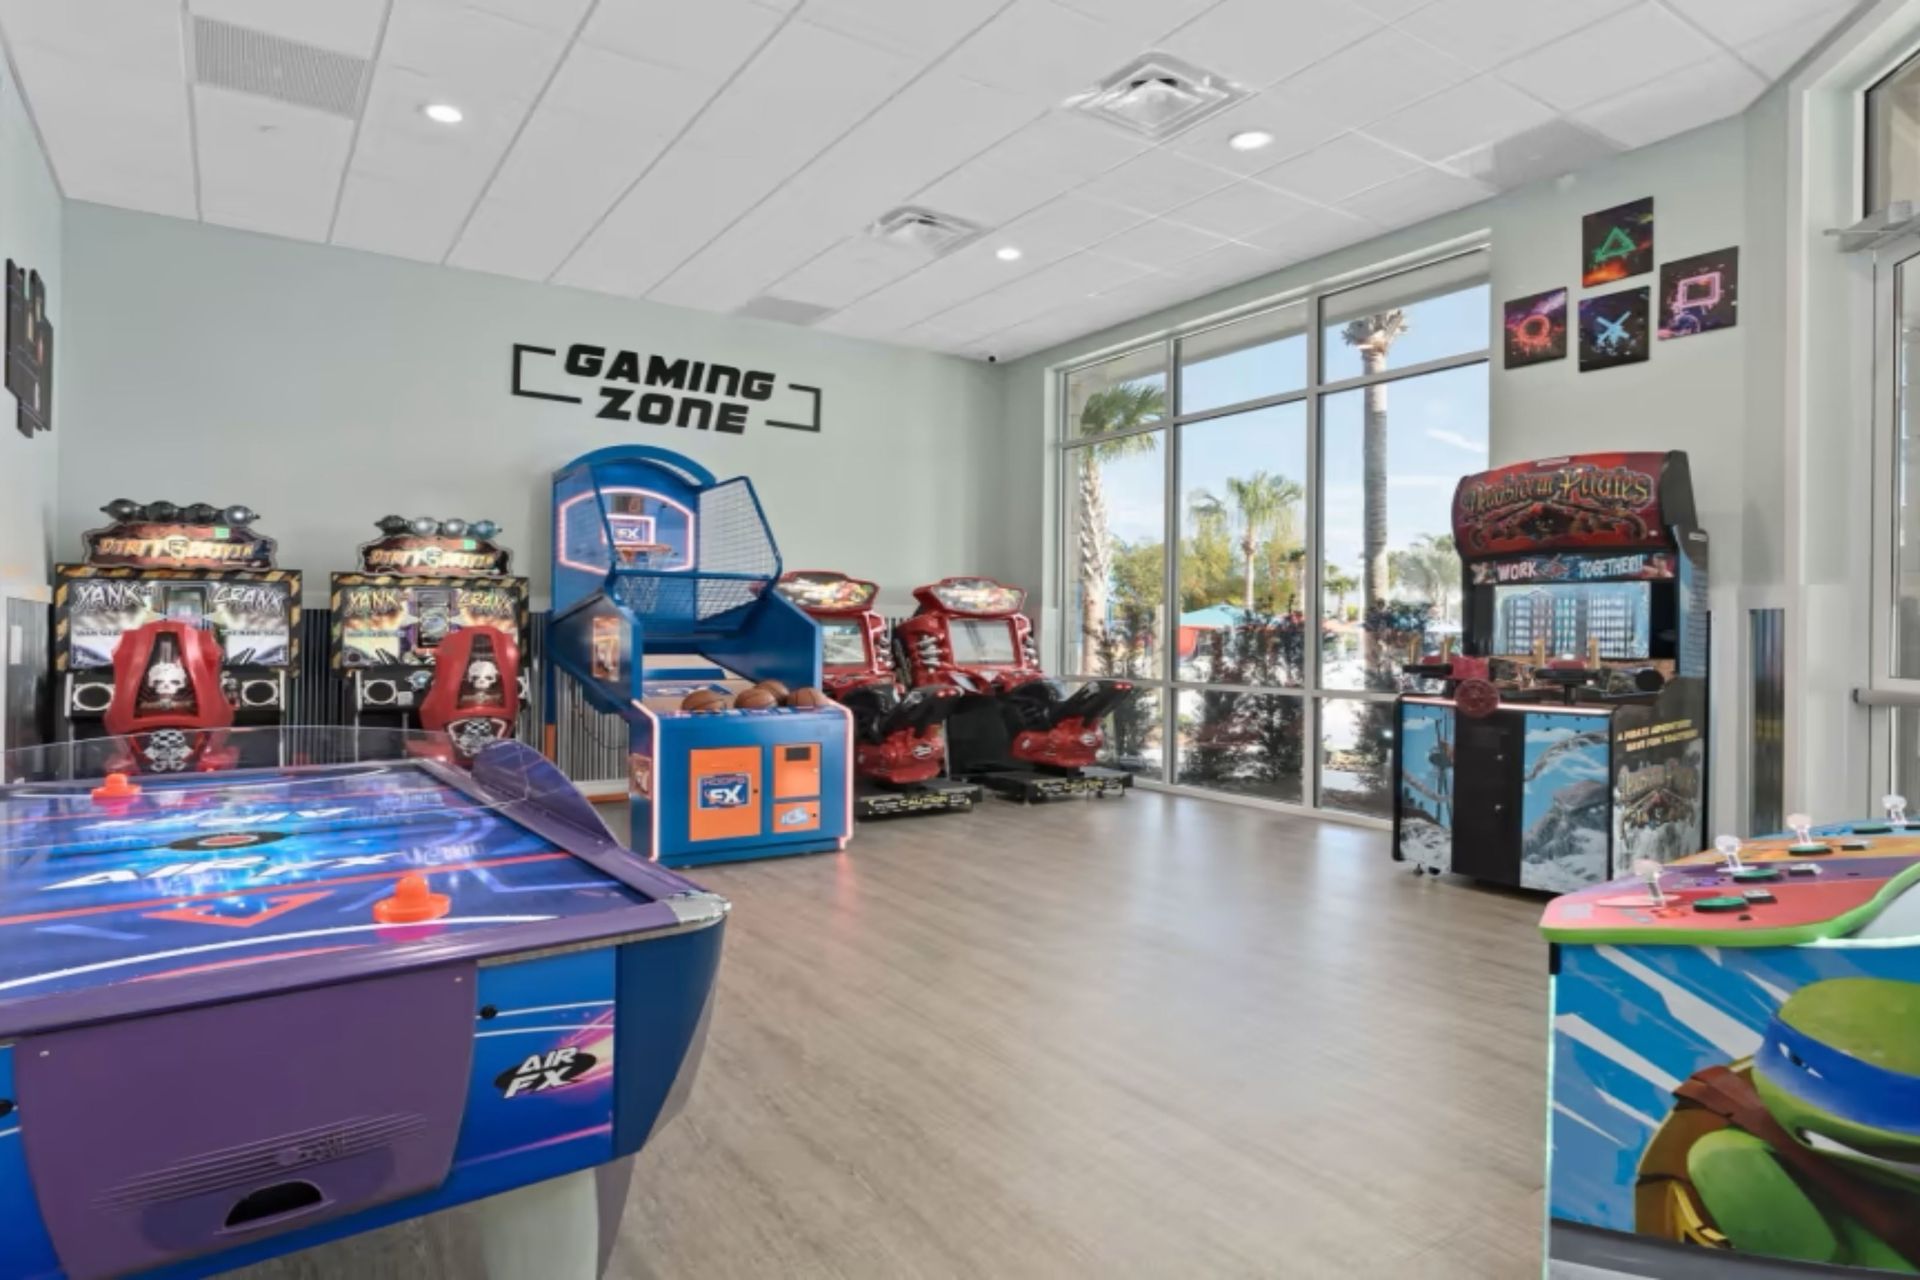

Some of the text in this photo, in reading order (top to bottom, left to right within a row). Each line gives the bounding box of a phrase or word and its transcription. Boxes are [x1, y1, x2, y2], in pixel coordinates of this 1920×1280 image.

[565, 344, 776, 401] GAMING
[596, 387, 749, 435] ZONE
[1497, 561, 1538, 581] WORK
[515, 1047, 578, 1075] AIR
[503, 1066, 574, 1099] FX
